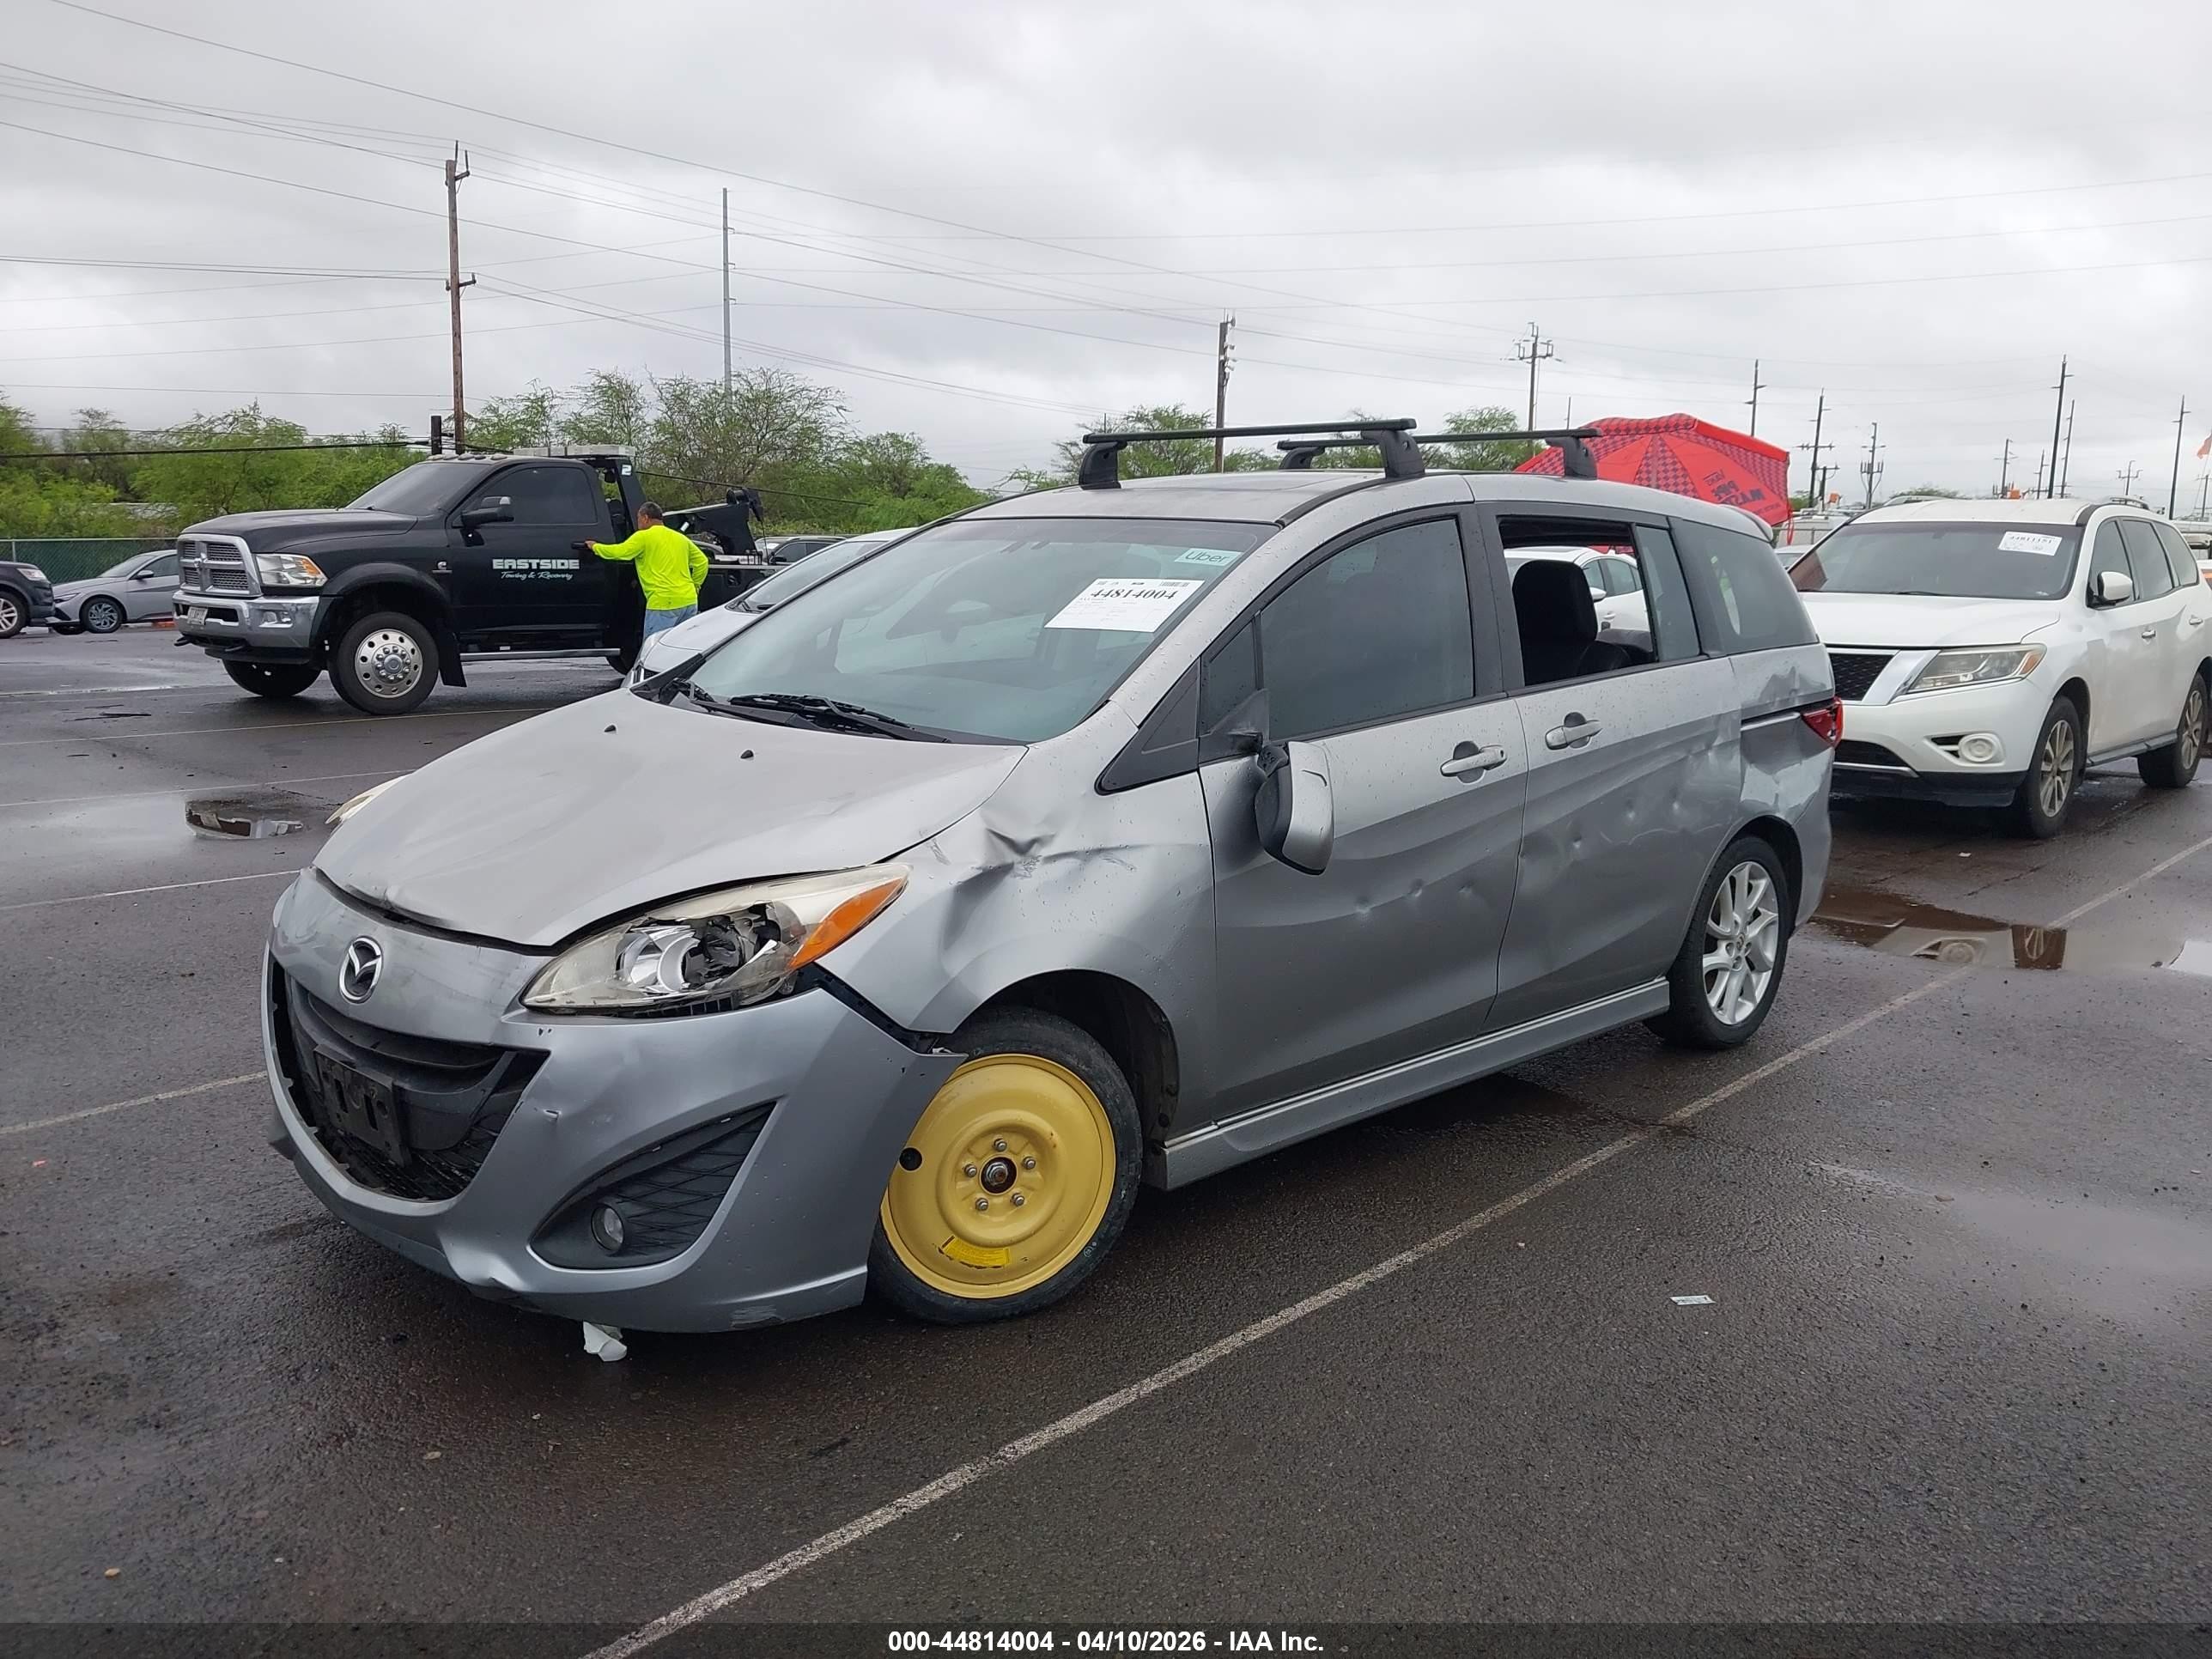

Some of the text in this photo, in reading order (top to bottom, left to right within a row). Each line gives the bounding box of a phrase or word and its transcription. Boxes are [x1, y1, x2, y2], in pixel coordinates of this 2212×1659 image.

[621, 465, 632, 476] 2
[1184, 550, 1231, 563] Uber
[492, 559, 580, 570] EASTSIDE
[501, 571, 574, 581] Towing & Recovery
[1090, 588, 1179, 600] 44814004
